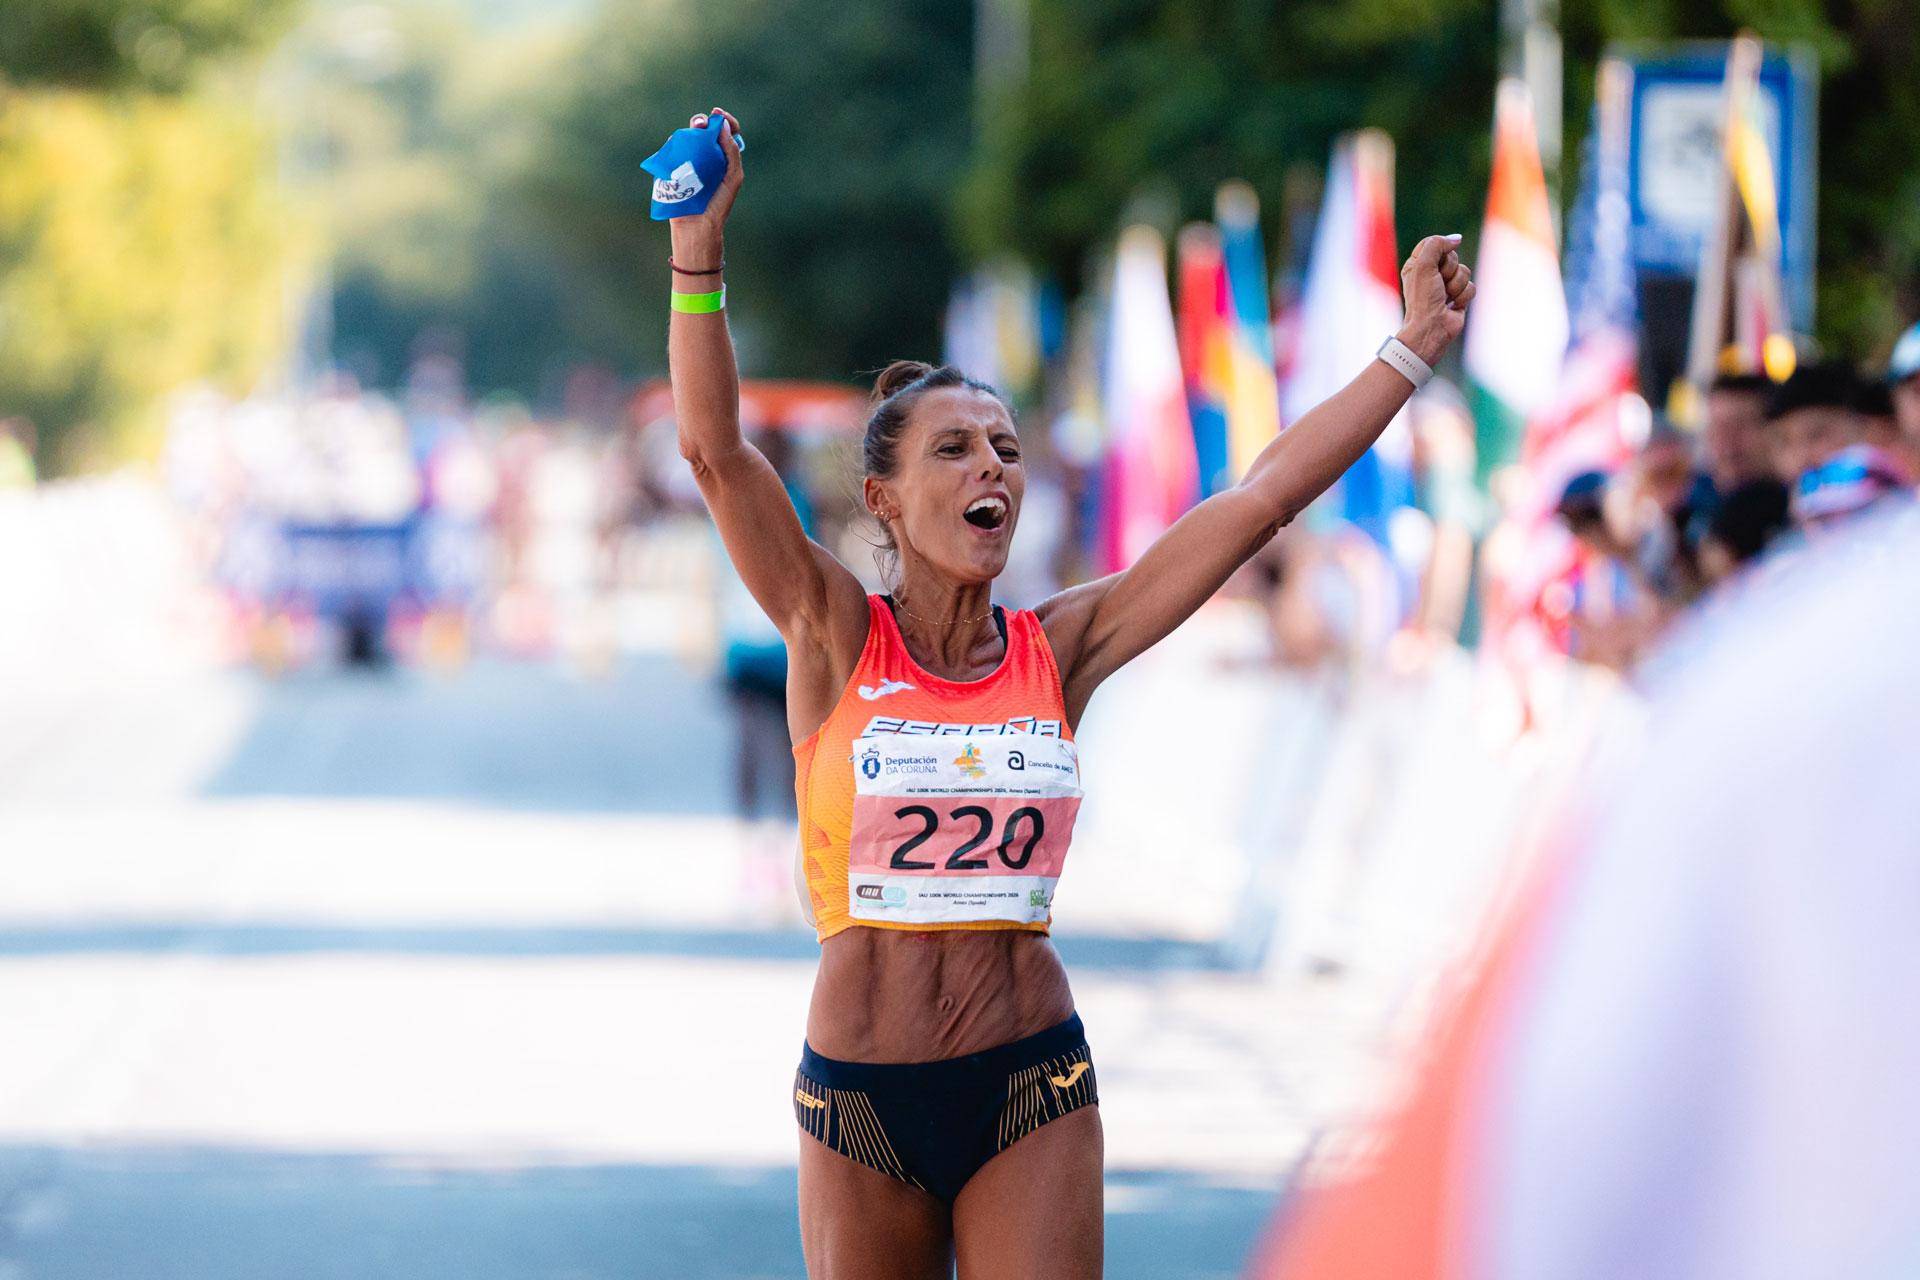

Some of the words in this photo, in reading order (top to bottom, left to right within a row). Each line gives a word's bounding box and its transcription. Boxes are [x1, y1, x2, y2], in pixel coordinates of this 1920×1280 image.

[885, 756, 937, 766] Deputación
[1027, 760, 1053, 769] Concello
[886, 766, 898, 775] DA
[889, 804, 1045, 870] 220
[861, 887, 880, 897] IAU
[796, 1088, 825, 1109] ESP
